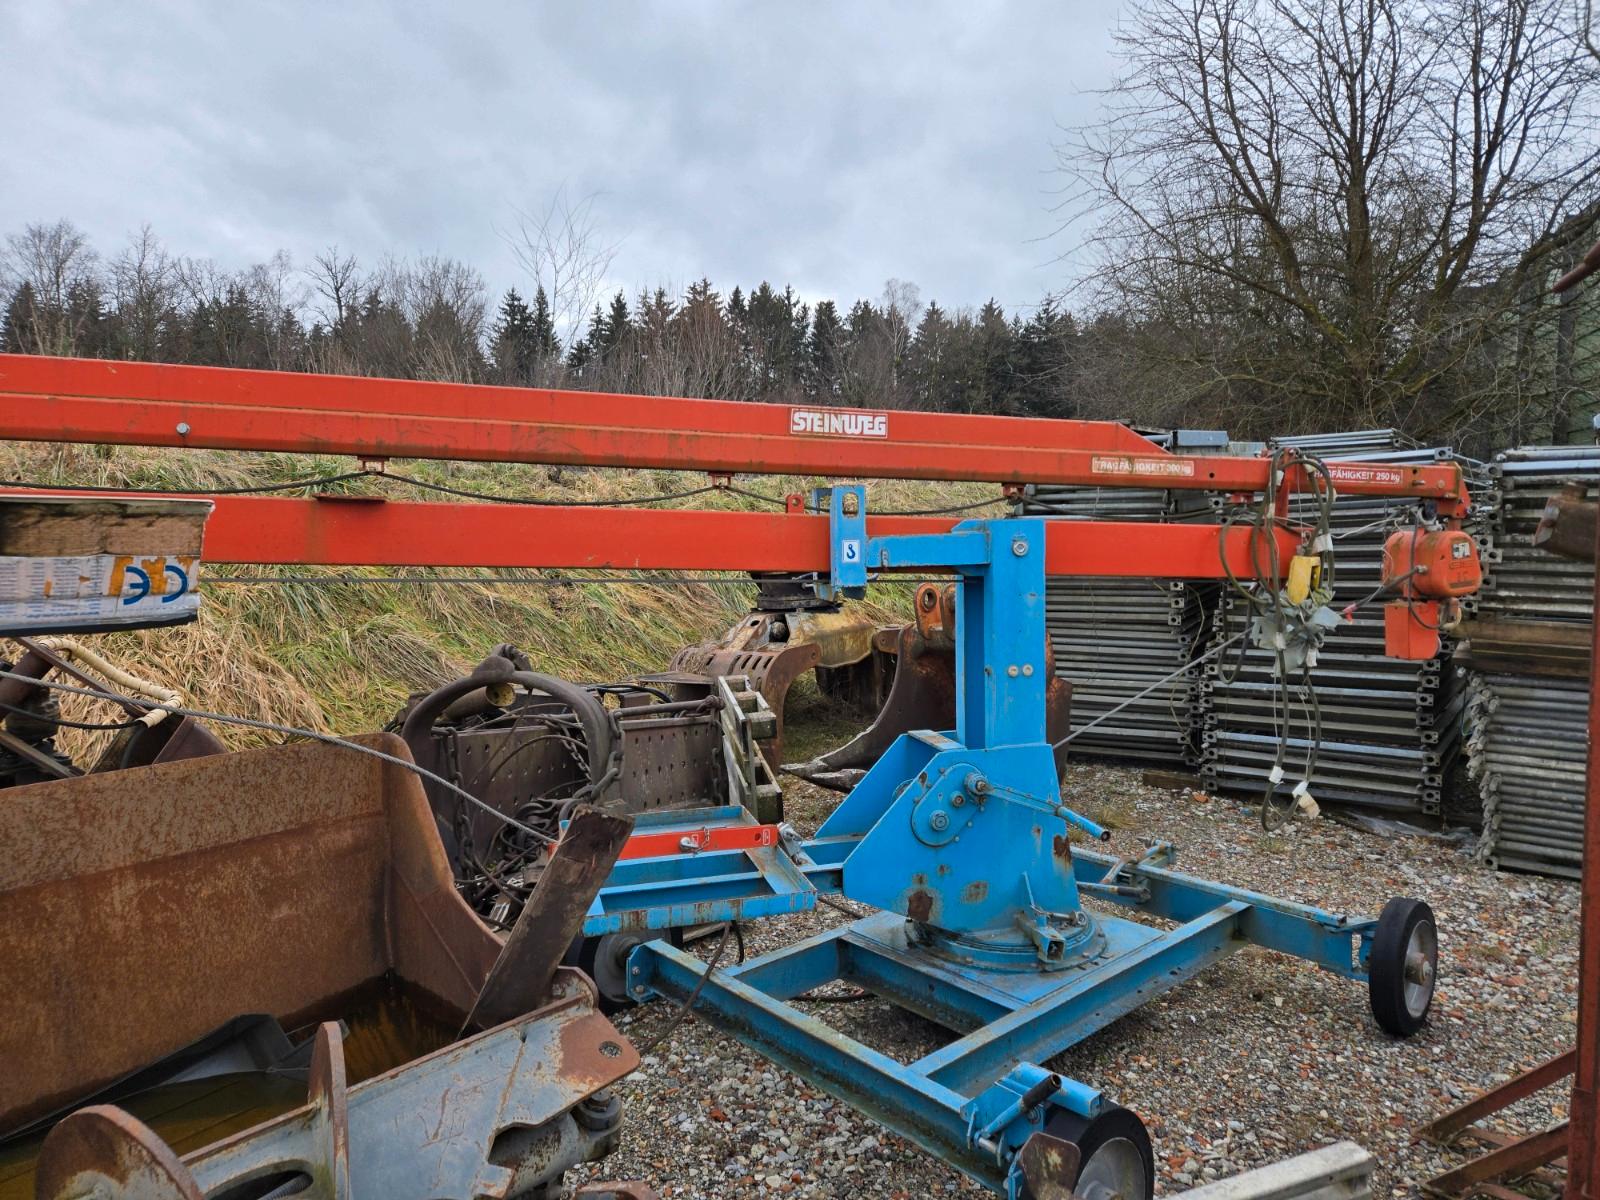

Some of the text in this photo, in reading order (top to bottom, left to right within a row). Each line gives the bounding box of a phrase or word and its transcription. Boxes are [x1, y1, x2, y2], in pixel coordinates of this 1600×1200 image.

[792, 411, 886, 436] STEINWEG
[1375, 472, 1390, 481] 250
[1390, 474, 1400, 483] kg
